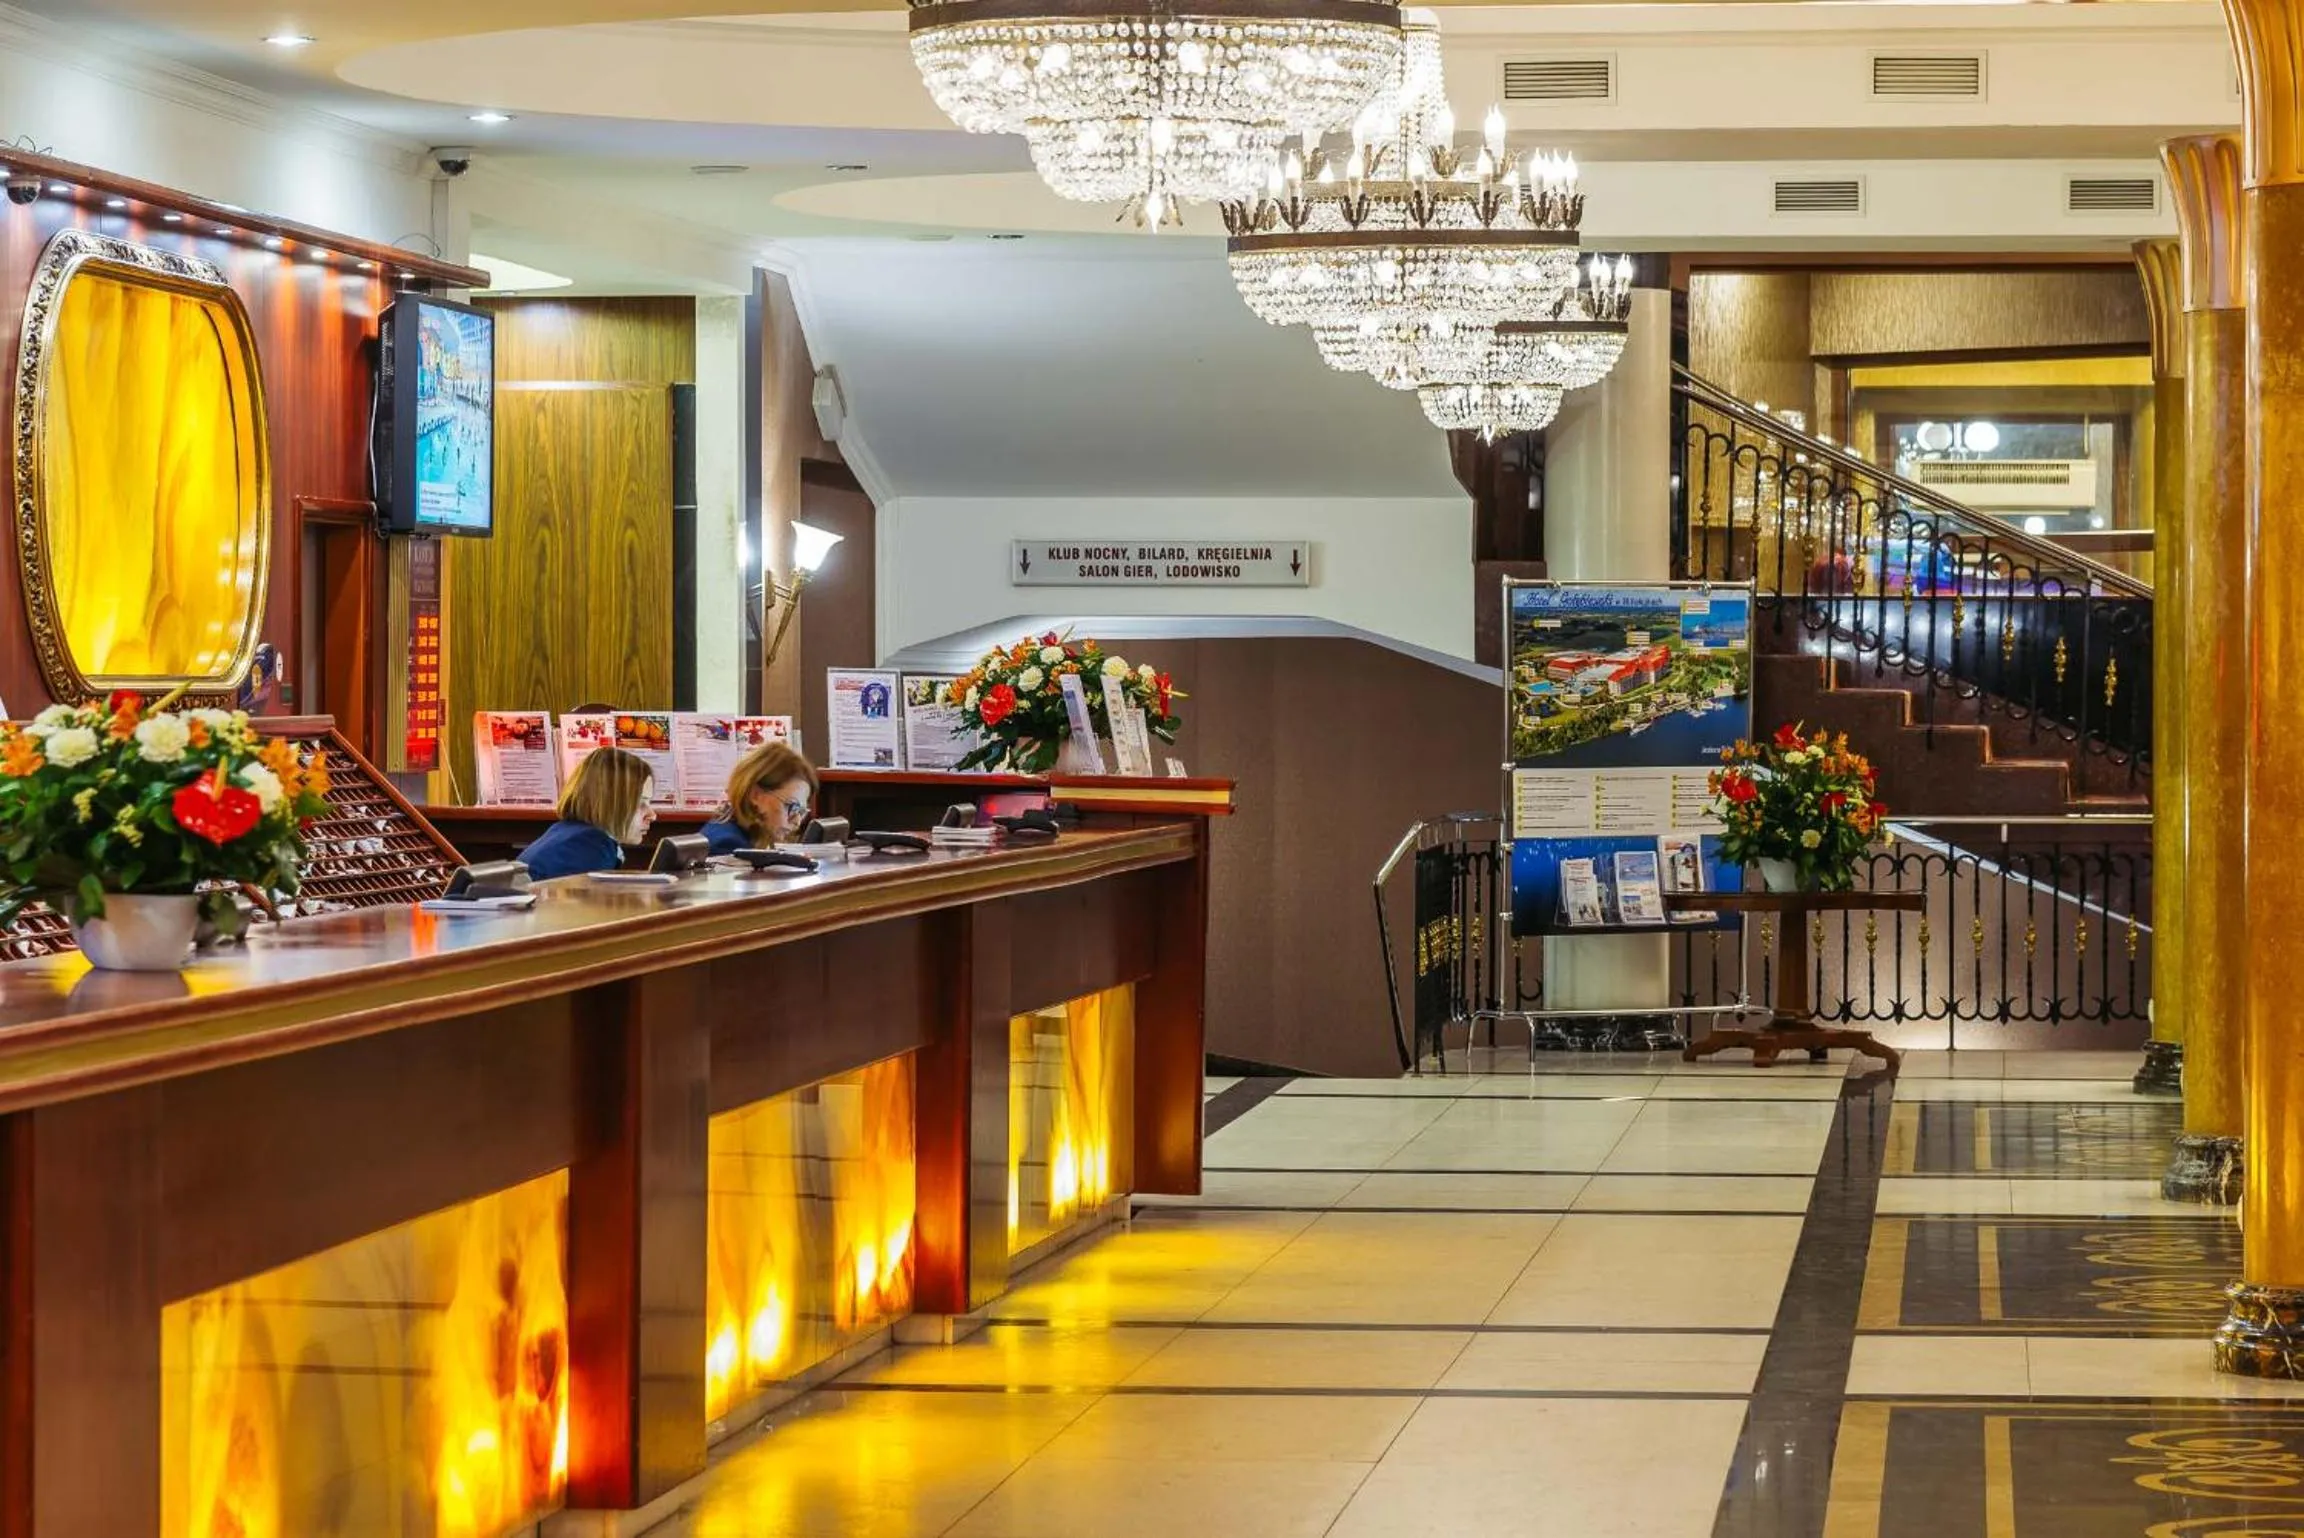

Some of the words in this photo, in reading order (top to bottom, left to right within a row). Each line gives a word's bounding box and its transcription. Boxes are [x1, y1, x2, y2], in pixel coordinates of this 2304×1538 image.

[1048, 547, 1080, 560] KLUB
[1084, 547, 1130, 561] NOCNY,
[1138, 547, 1189, 562] BILARD,
[1197, 547, 1273, 563] KRĘGIELNIA
[1079, 564, 1119, 577] SALON
[1123, 564, 1158, 579] GIER,
[1166, 564, 1241, 578] LODOWISKO
